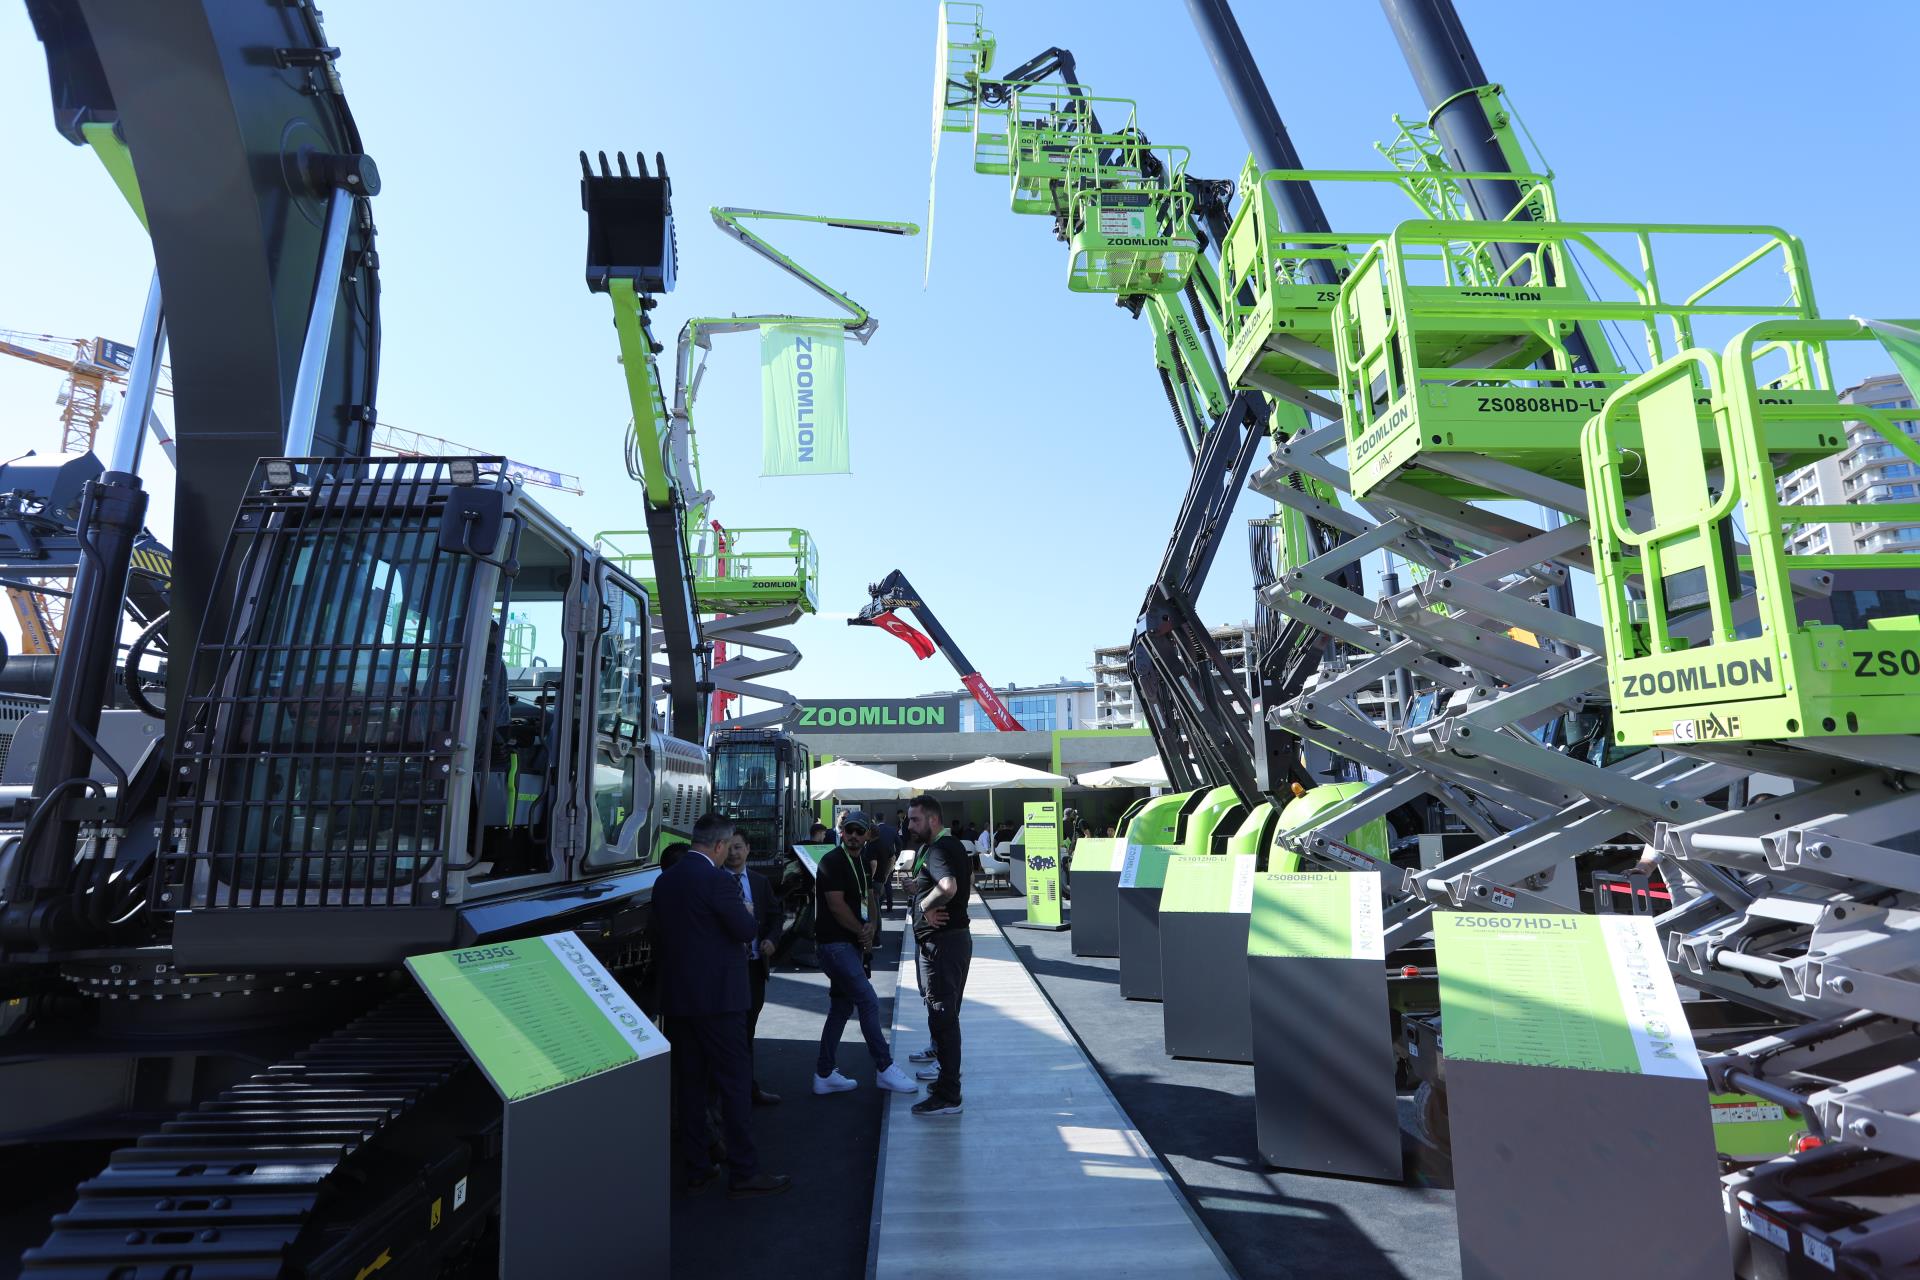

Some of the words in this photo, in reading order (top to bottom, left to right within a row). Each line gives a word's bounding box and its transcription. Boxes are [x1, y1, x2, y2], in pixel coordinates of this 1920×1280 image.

[1107, 238, 1168, 246] ZOOMLION
[795, 336, 815, 463] ZOOMLION
[1477, 397, 1605, 412] ZS0808HD-Li
[1355, 404, 1409, 461] ZOOMLION
[1622, 656, 1774, 698] ZOOMLION
[978, 682, 993, 701] SANY
[799, 706, 945, 726] ZOOMLION
[1695, 712, 1740, 739] IPAF
[1675, 721, 1694, 739] CE
[1267, 873, 1337, 881] ZS0808HD-Li
[1454, 916, 1578, 930] ZS0607HD-Li
[453, 945, 514, 965] ZE335G
[554, 937, 651, 1043] ZOOMLION
